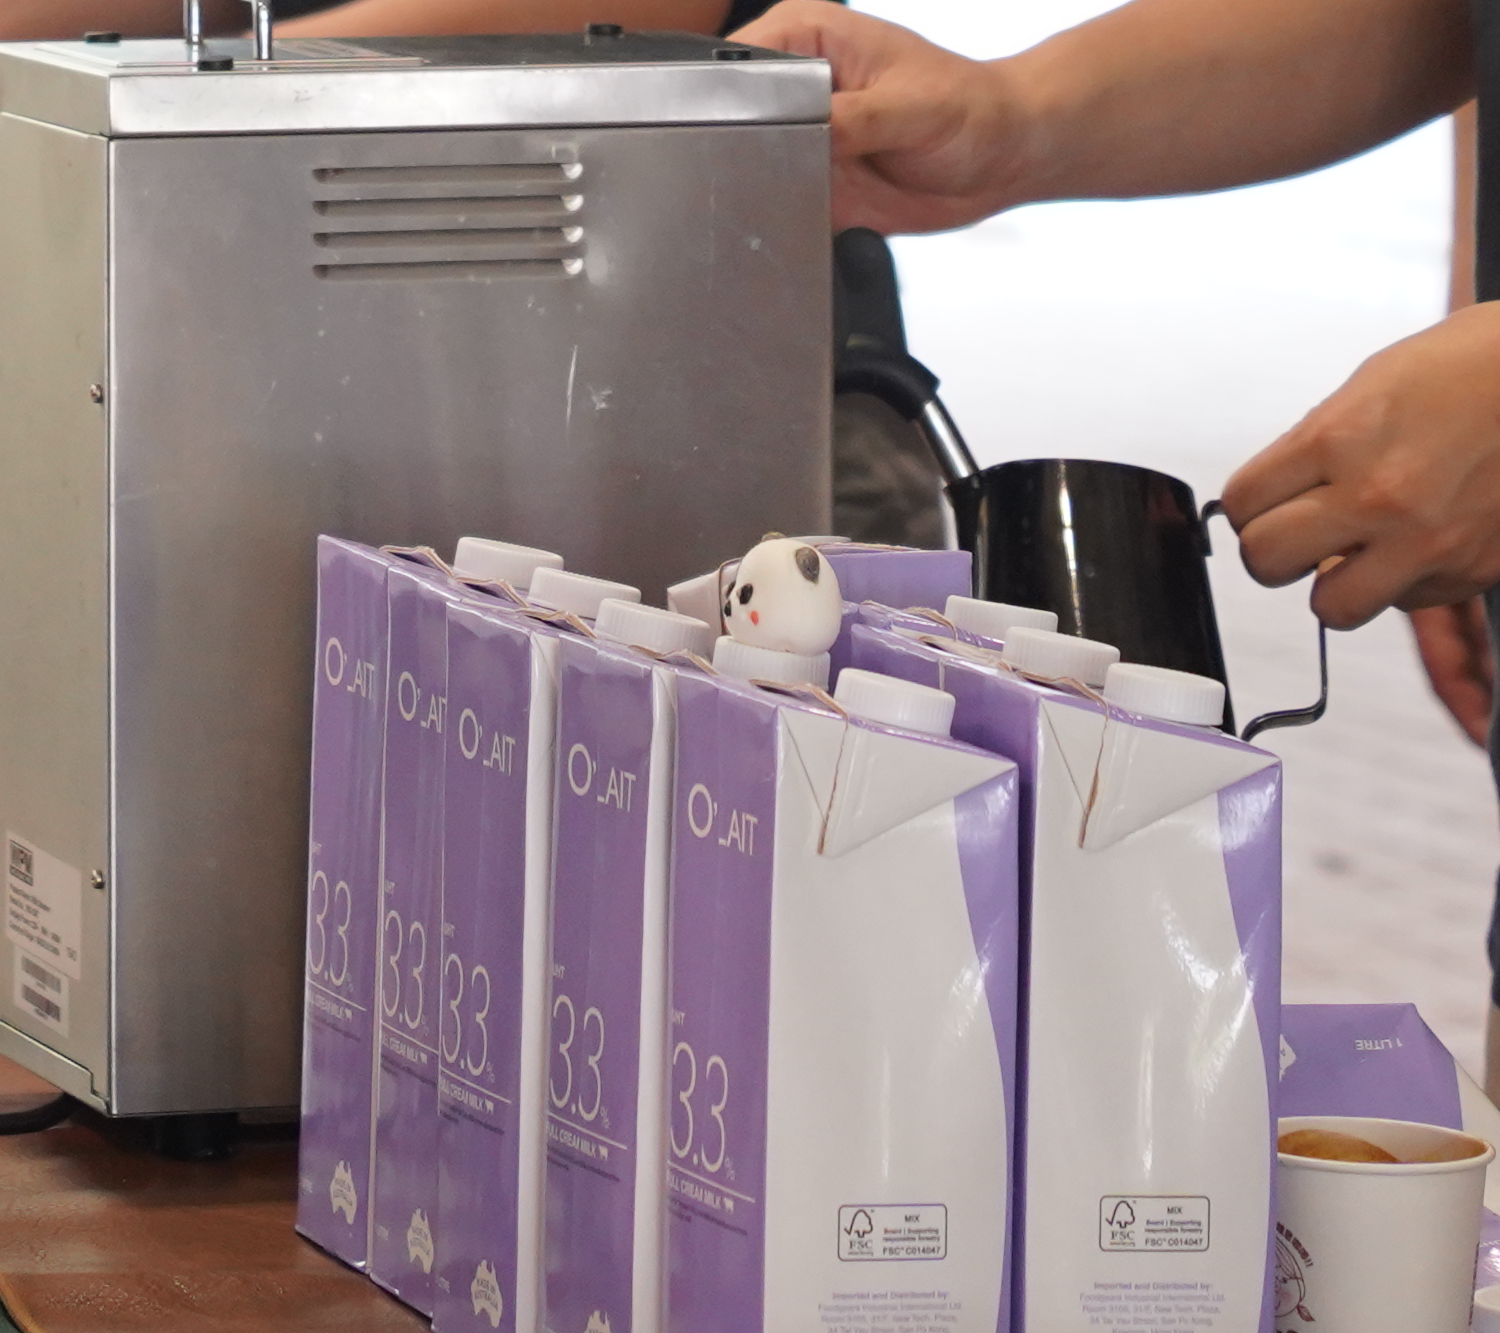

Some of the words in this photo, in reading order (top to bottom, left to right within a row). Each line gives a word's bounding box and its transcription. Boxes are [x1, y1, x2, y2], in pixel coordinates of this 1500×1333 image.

[1354, 1039, 1393, 1051] LITRE
[1166, 1206, 1183, 1215] MIX
[904, 1214, 920, 1223] MIX
[1110, 1229, 1135, 1241] FSC
[848, 1239, 873, 1250] FSC
